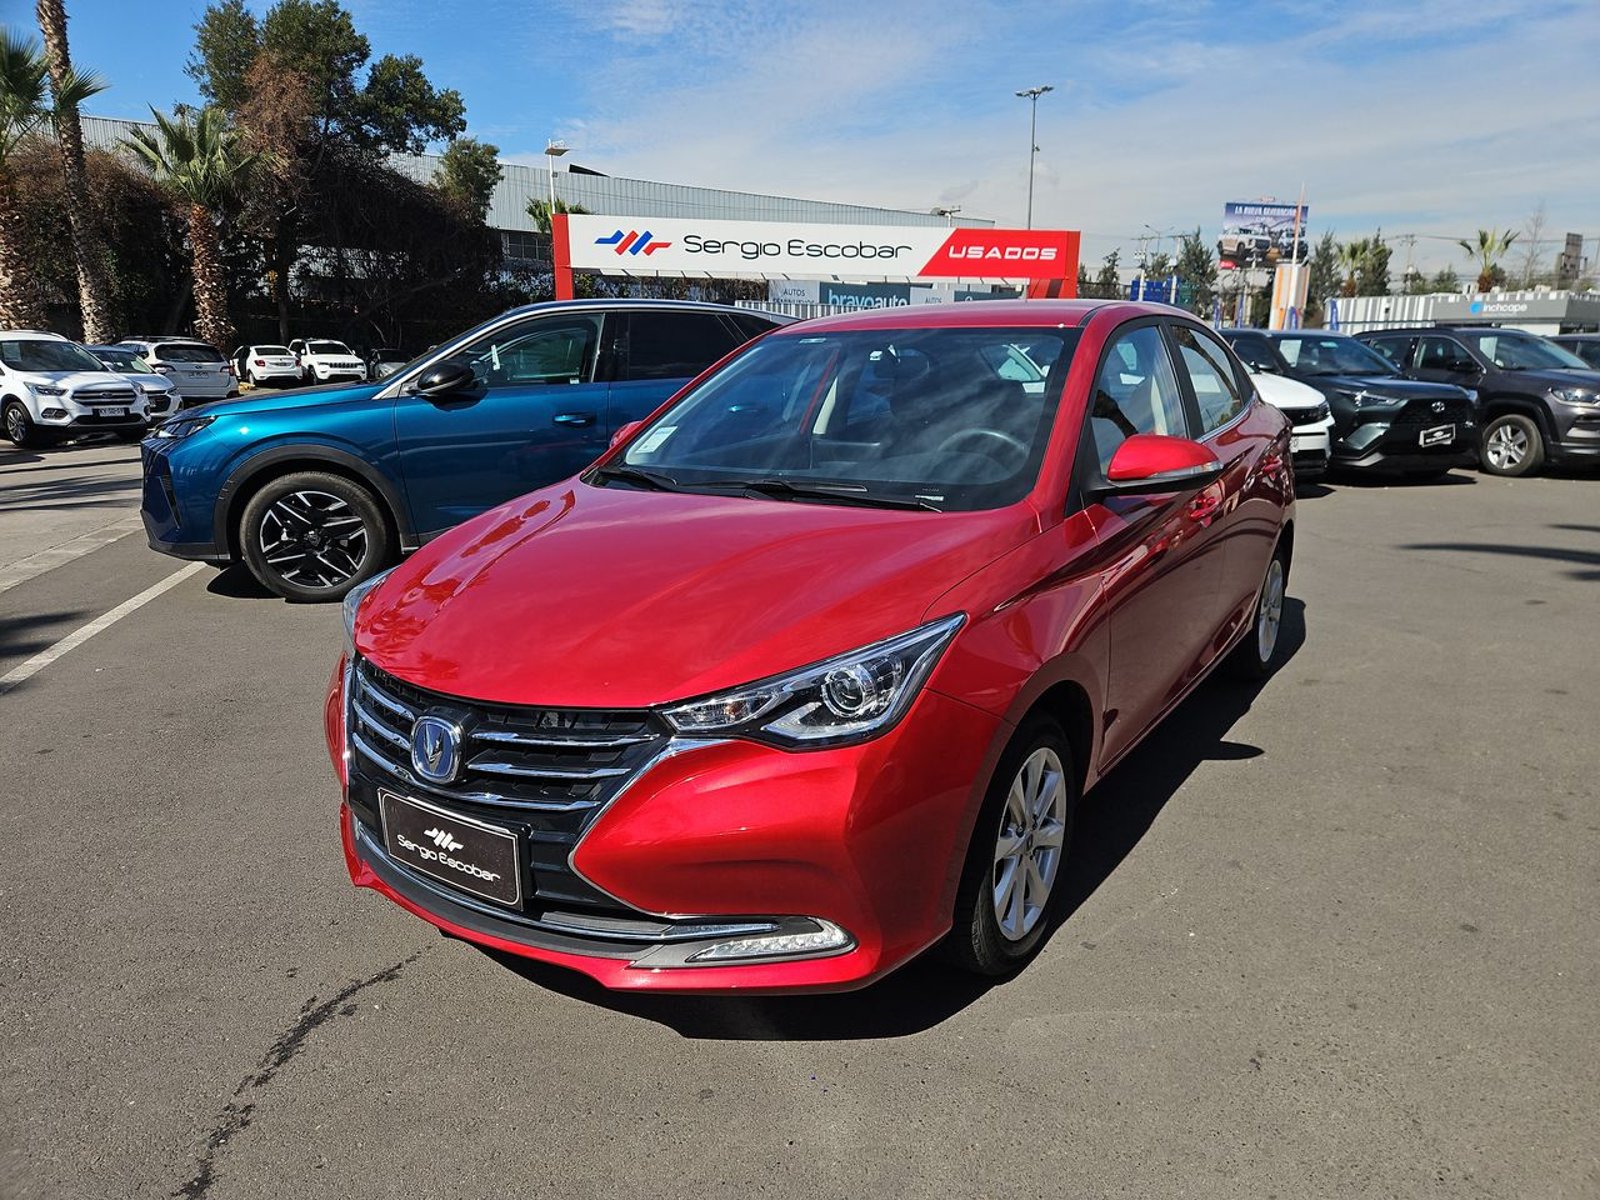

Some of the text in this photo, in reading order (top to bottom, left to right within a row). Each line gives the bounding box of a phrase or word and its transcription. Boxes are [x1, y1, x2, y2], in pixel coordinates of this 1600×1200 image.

[683, 235, 913, 260] Sergio Escobar
[948, 245, 1057, 260] USADOS
[783, 289, 806, 297] AUTOS
[828, 289, 908, 308] bravoauto
[438, 851, 501, 882] Escobar
